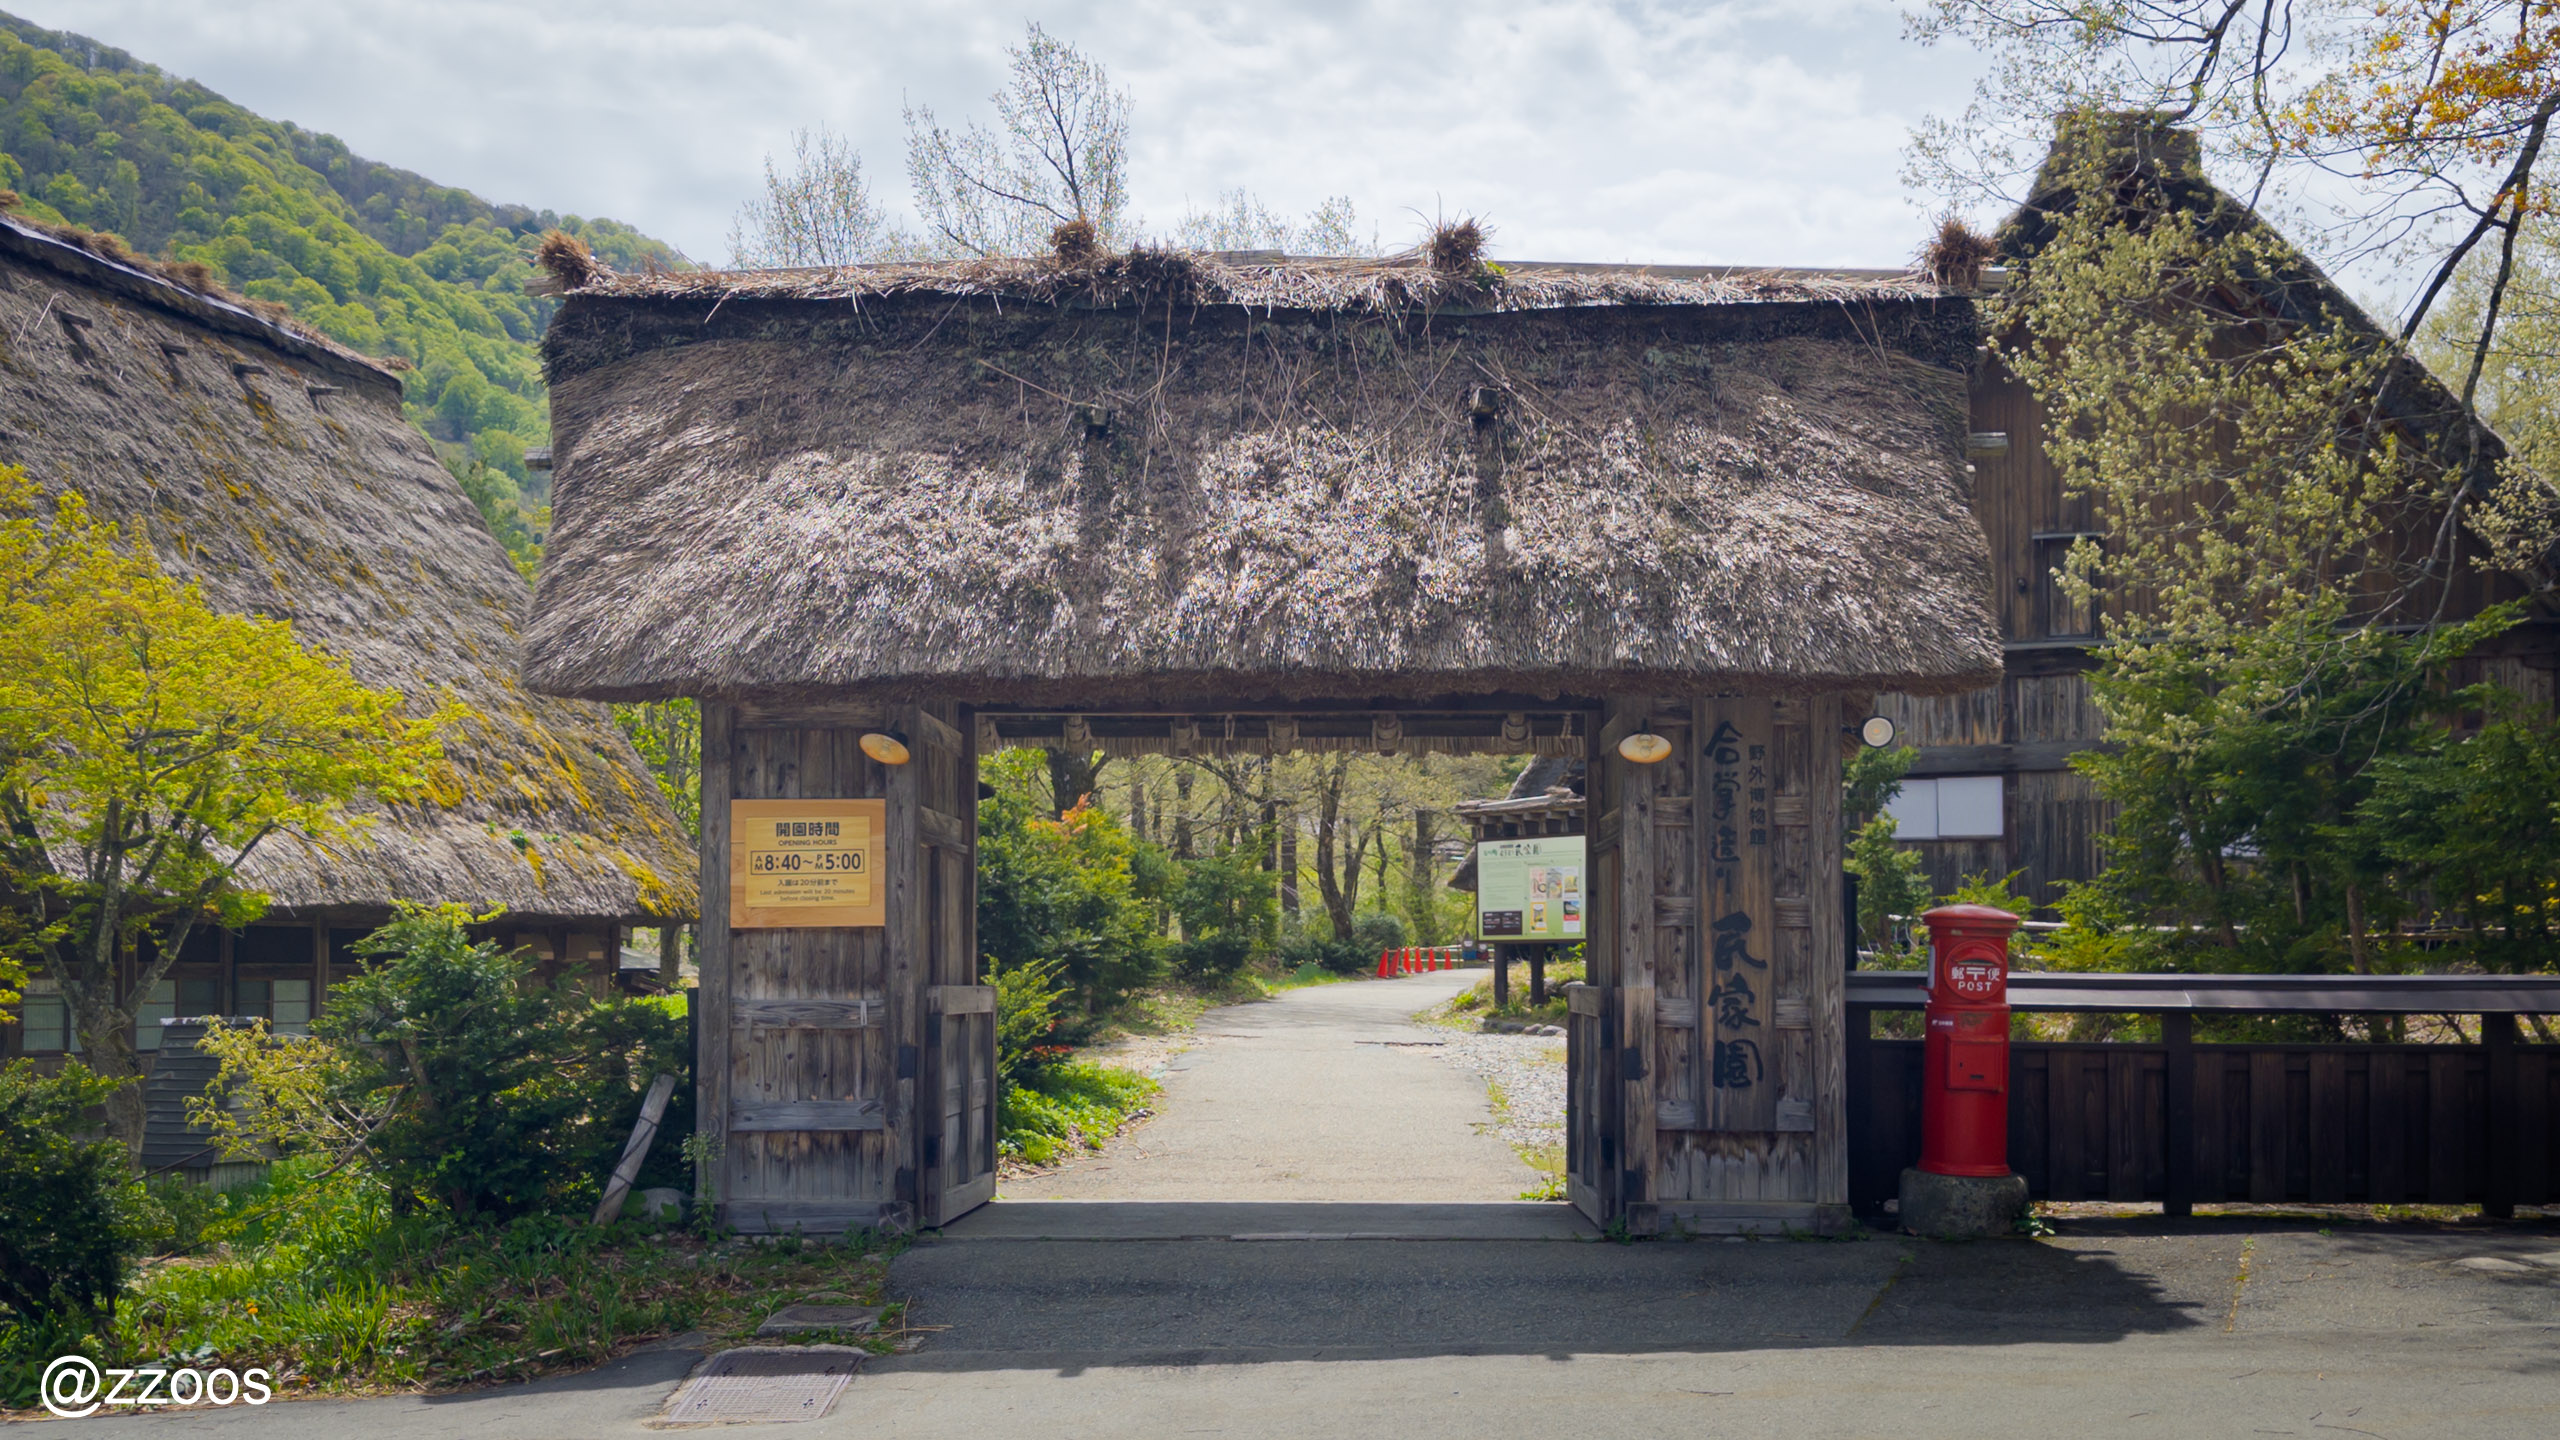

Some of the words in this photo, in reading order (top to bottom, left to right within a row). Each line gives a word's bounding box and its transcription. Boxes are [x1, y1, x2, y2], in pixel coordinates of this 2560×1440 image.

[1748, 744, 1767, 846] 野外博物館
[776, 821, 840, 837] 開園時間
[778, 839, 811, 847] OPENING
[1958, 980, 1993, 992] POST
